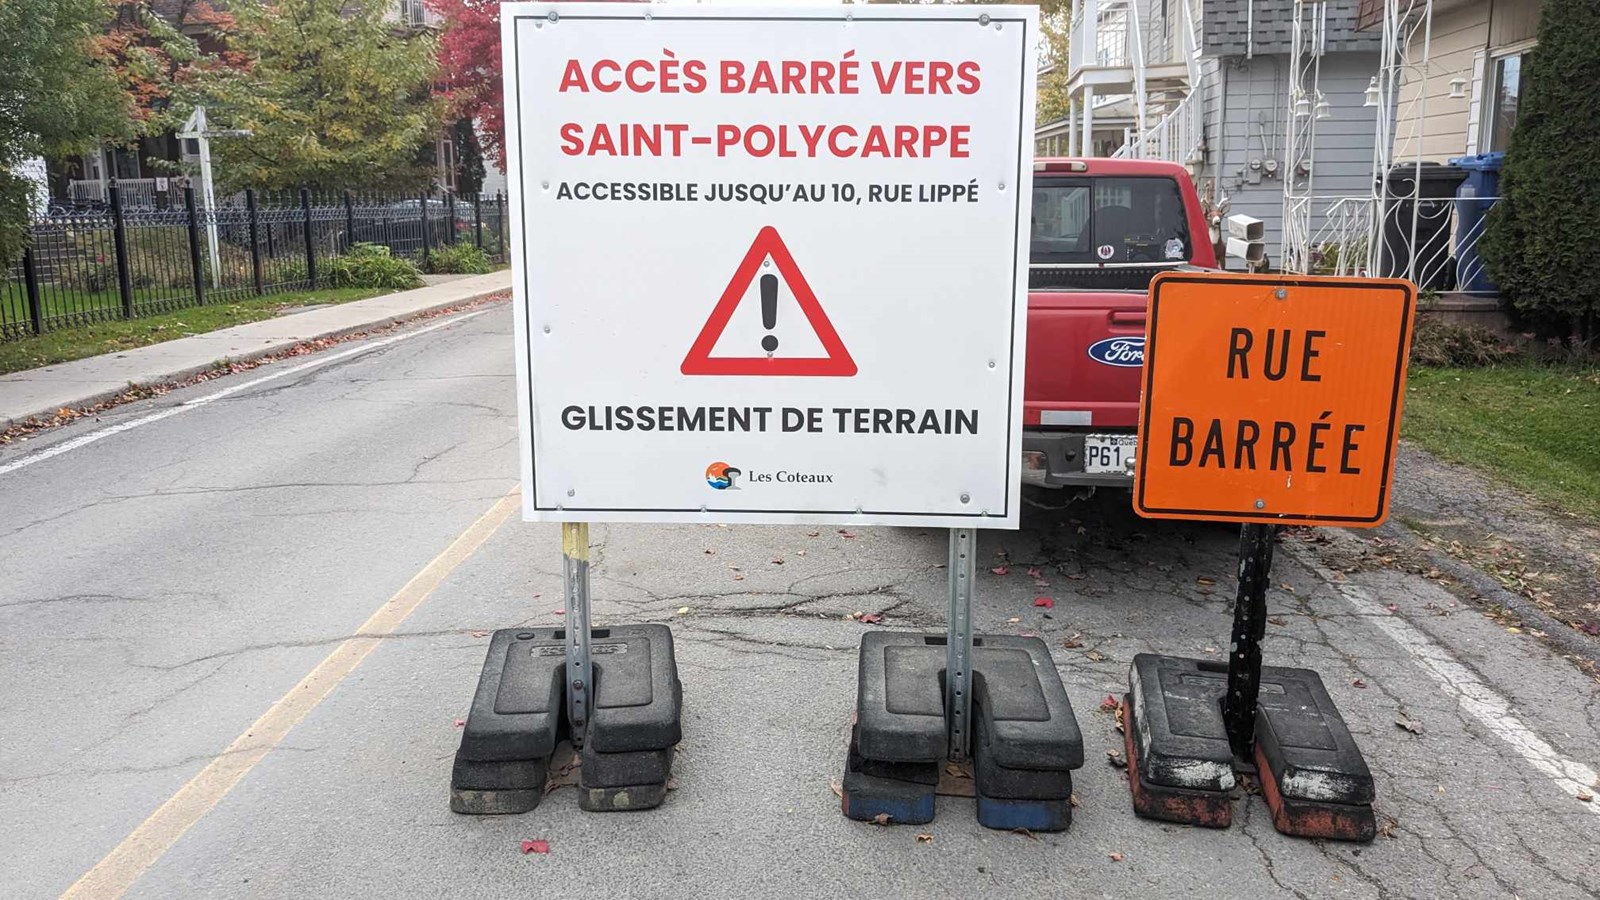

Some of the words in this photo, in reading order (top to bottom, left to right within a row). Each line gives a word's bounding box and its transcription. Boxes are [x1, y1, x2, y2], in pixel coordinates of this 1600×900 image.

[559, 48, 707, 93] ACCÈS
[720, 50, 859, 94] BARRÉ
[871, 61, 981, 94] VERS
[560, 123, 970, 158] SAINT-POLYCARPE
[556, 182, 698, 202] ACCESSIBLE
[832, 184, 862, 205] 10,
[868, 185, 912, 203] RUE
[919, 178, 979, 203] LIPPÉ
[1226, 327, 1326, 382] RUE
[561, 406, 772, 433] GLISSEMENT
[782, 407, 823, 433] DE
[833, 408, 979, 435] TERRAIN
[1169, 410, 1365, 475] BARRÉE
[749, 470, 772, 483] Les
[776, 470, 833, 483] Coteaux
